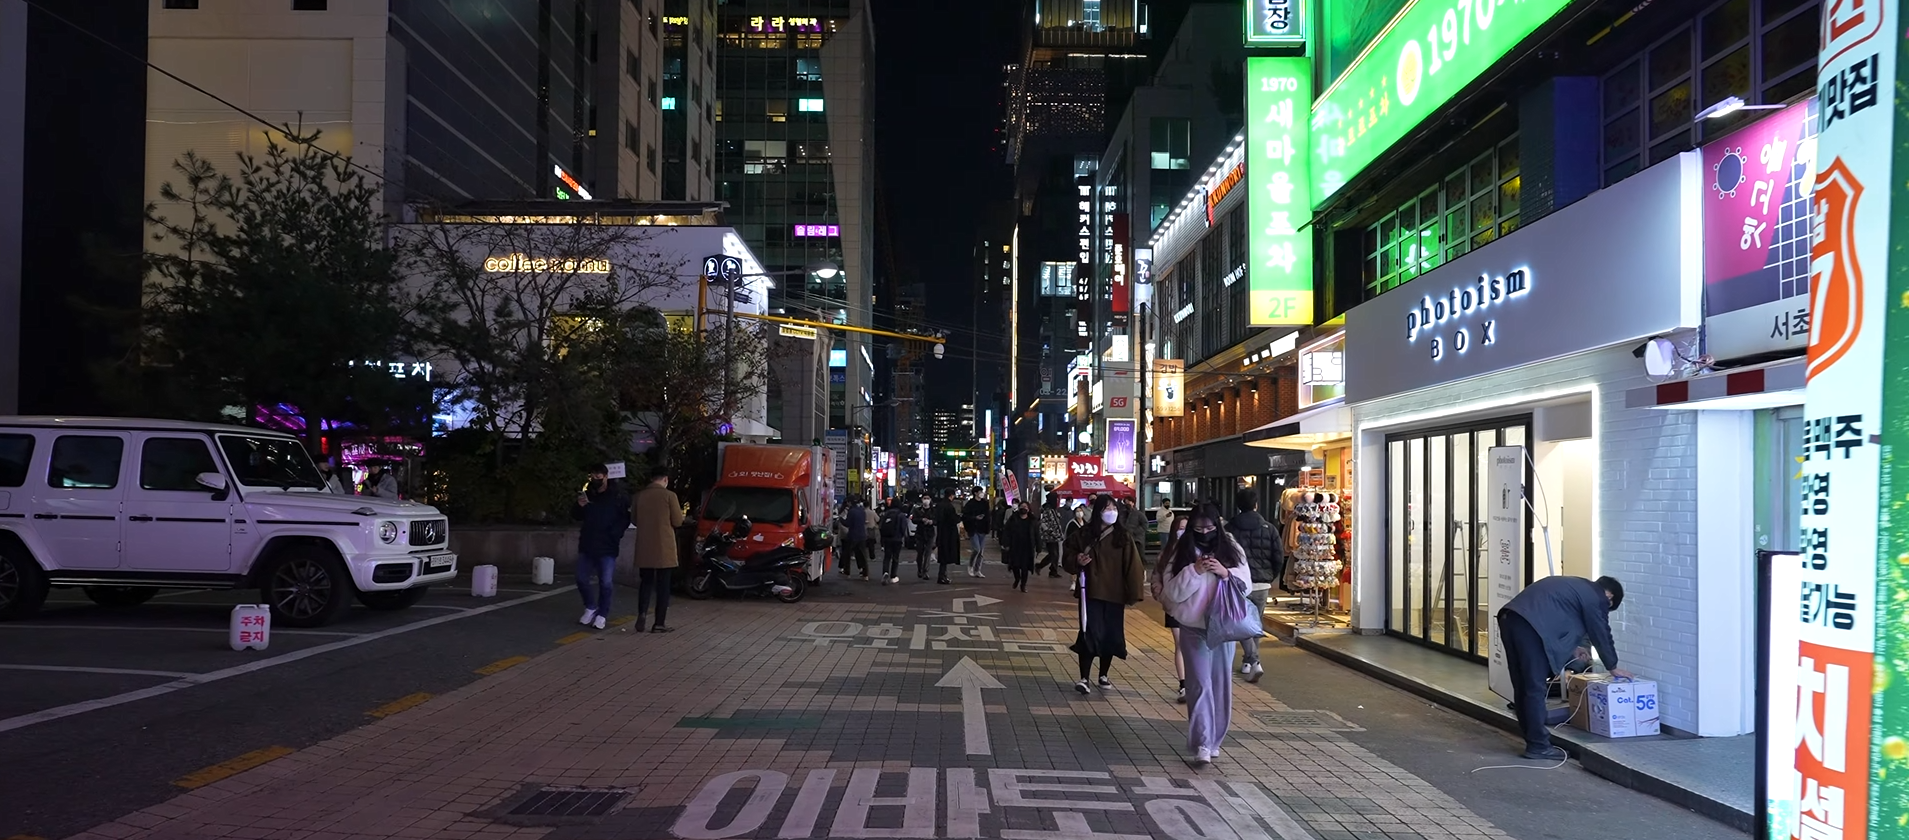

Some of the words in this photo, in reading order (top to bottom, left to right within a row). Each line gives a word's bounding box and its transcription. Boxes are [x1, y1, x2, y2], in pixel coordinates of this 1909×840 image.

[1427, 0, 1495, 76] 1970
[1261, 77, 1298, 92] 1970
[1820, 53, 1879, 133] 맛집
[1265, 98, 1297, 274] 새마을포차
[485, 252, 547, 273] coffee
[1268, 296, 1297, 319] 2F
[1406, 268, 1528, 340] photoism
[1431, 320, 1493, 359] BOX
[1112, 398, 1124, 407] 5G
[240, 616, 265, 627] 주차
[1617, 696, 1634, 704] Cat.
[1636, 694, 1656, 711] 5e
